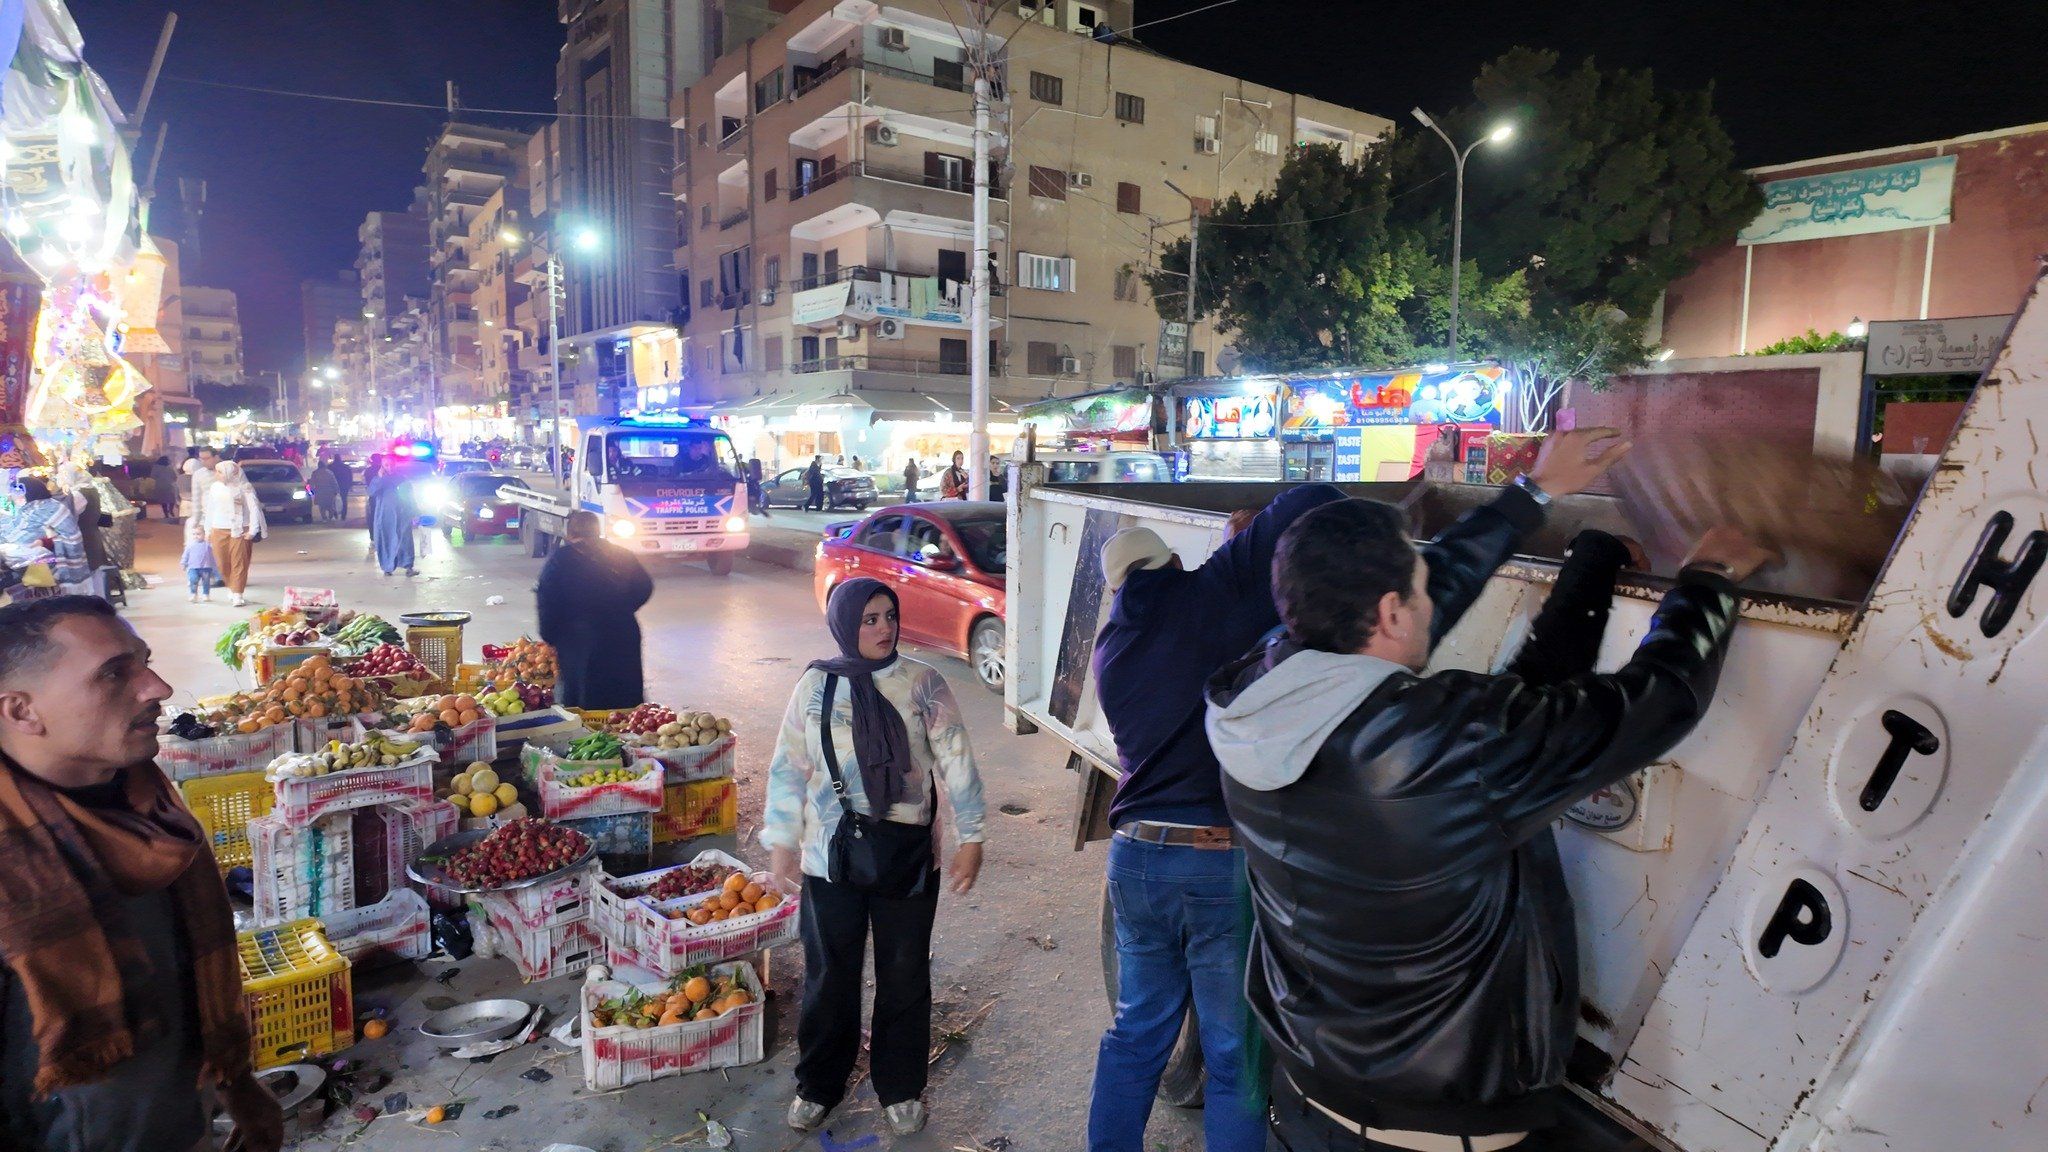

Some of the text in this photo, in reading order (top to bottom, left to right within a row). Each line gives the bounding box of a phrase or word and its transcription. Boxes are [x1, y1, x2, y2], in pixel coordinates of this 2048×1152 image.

[1338, 436, 1361, 447] TASTE
[1337, 455, 1360, 465] TASTE
[656, 488, 706, 497] CHEVROLET
[656, 506, 708, 514] TRAFFIC POLICE
[1947, 510, 2048, 638] H
[1859, 709, 1939, 812] T
[1758, 878, 1832, 959] P
